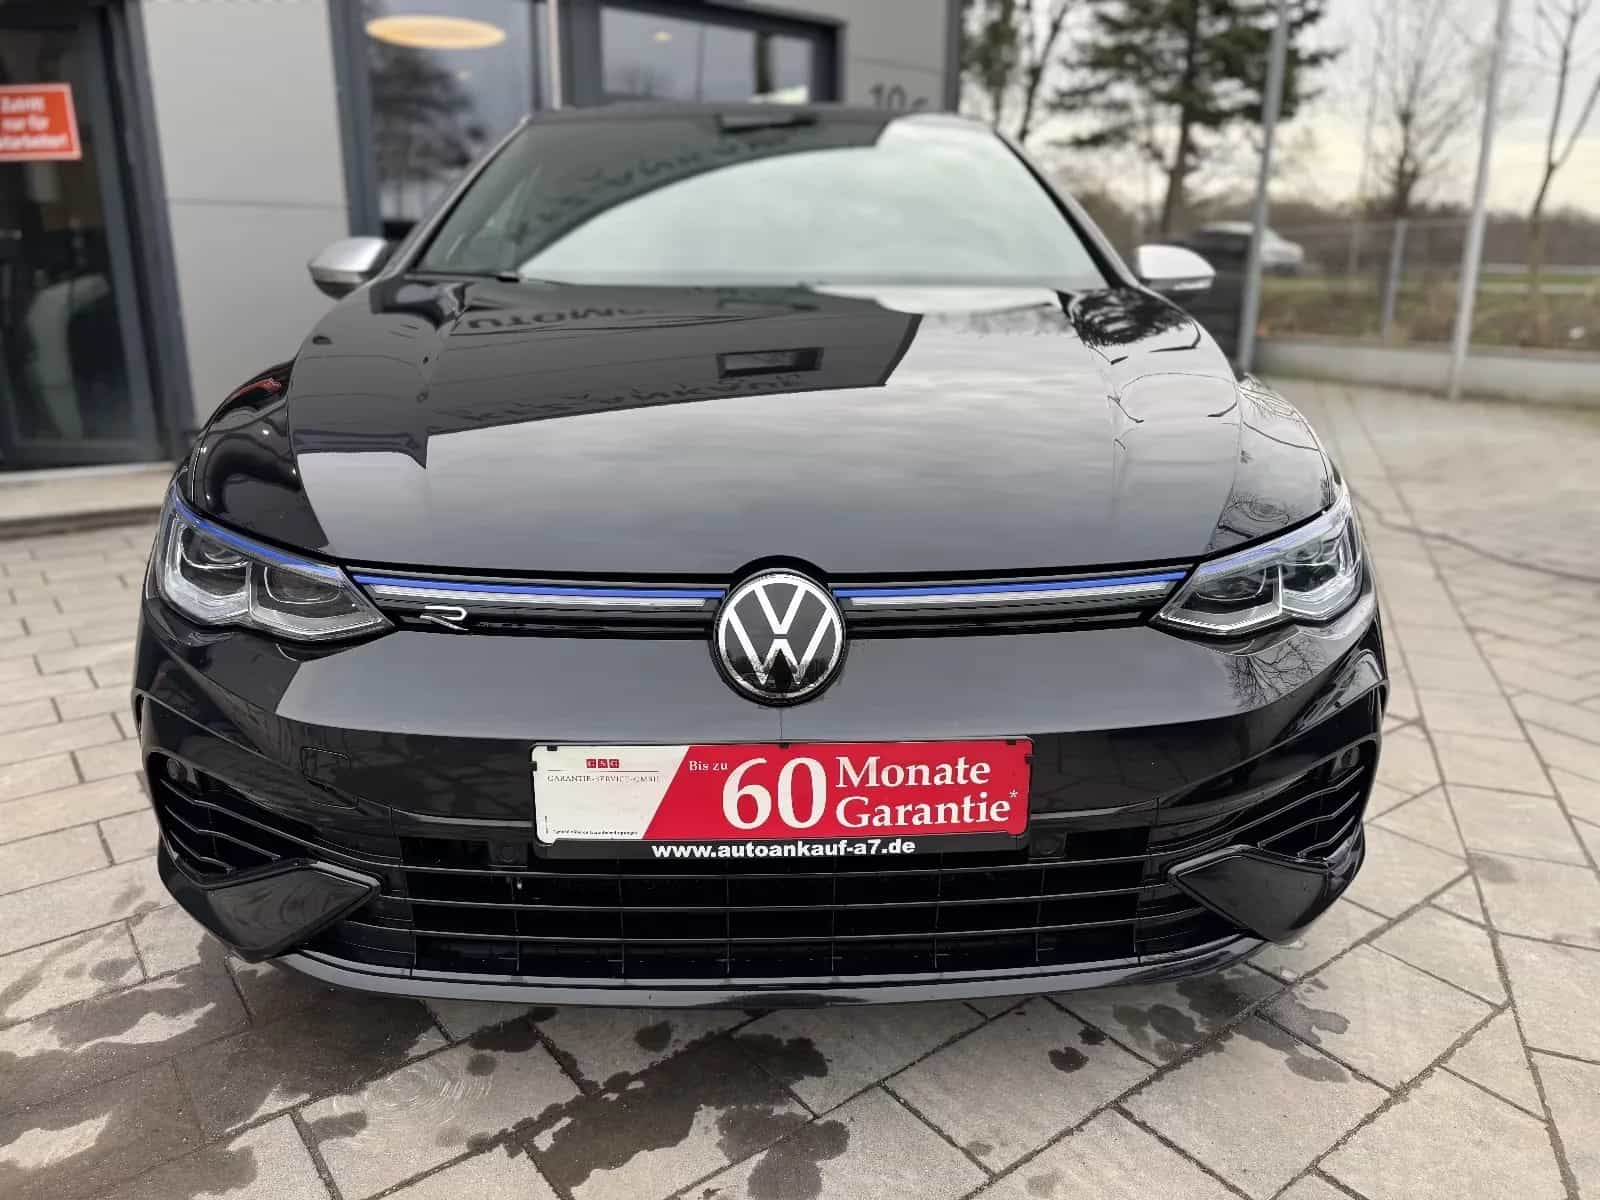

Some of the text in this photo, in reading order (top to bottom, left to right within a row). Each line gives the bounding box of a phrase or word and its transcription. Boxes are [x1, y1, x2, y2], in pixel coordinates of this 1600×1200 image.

[835, 755, 991, 789] Monate
[689, 757, 828, 830] Bis zu 60
[652, 839, 915, 857] www.autoankauf-a7.de
